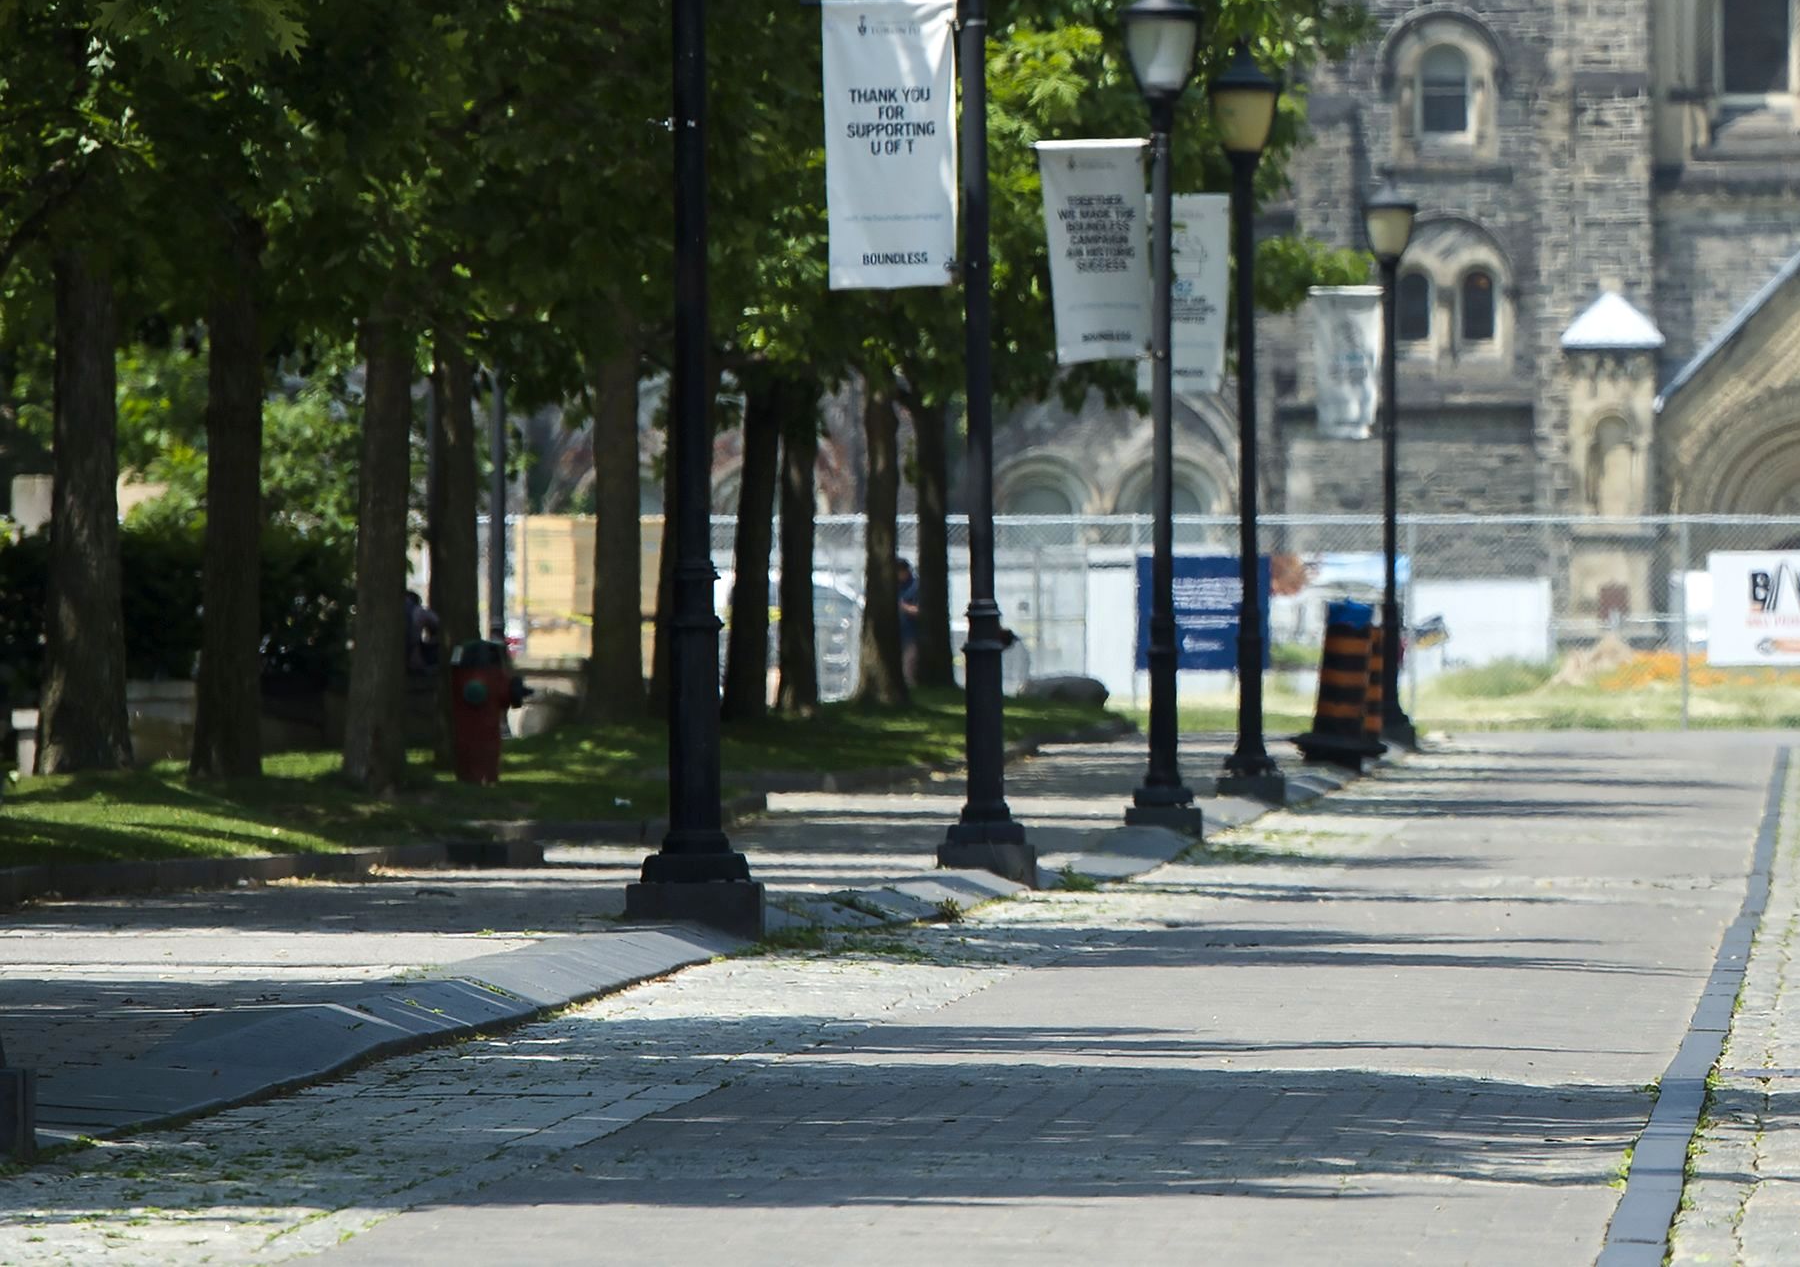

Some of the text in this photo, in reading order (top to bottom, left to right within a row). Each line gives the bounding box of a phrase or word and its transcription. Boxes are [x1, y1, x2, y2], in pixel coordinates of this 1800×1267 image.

[848, 86, 931, 104] THANK YOU
[878, 104, 905, 121] FOR
[846, 120, 936, 139] SUPPORTING
[870, 138, 914, 156] U OF T
[862, 250, 929, 266] BOUNDLESS
